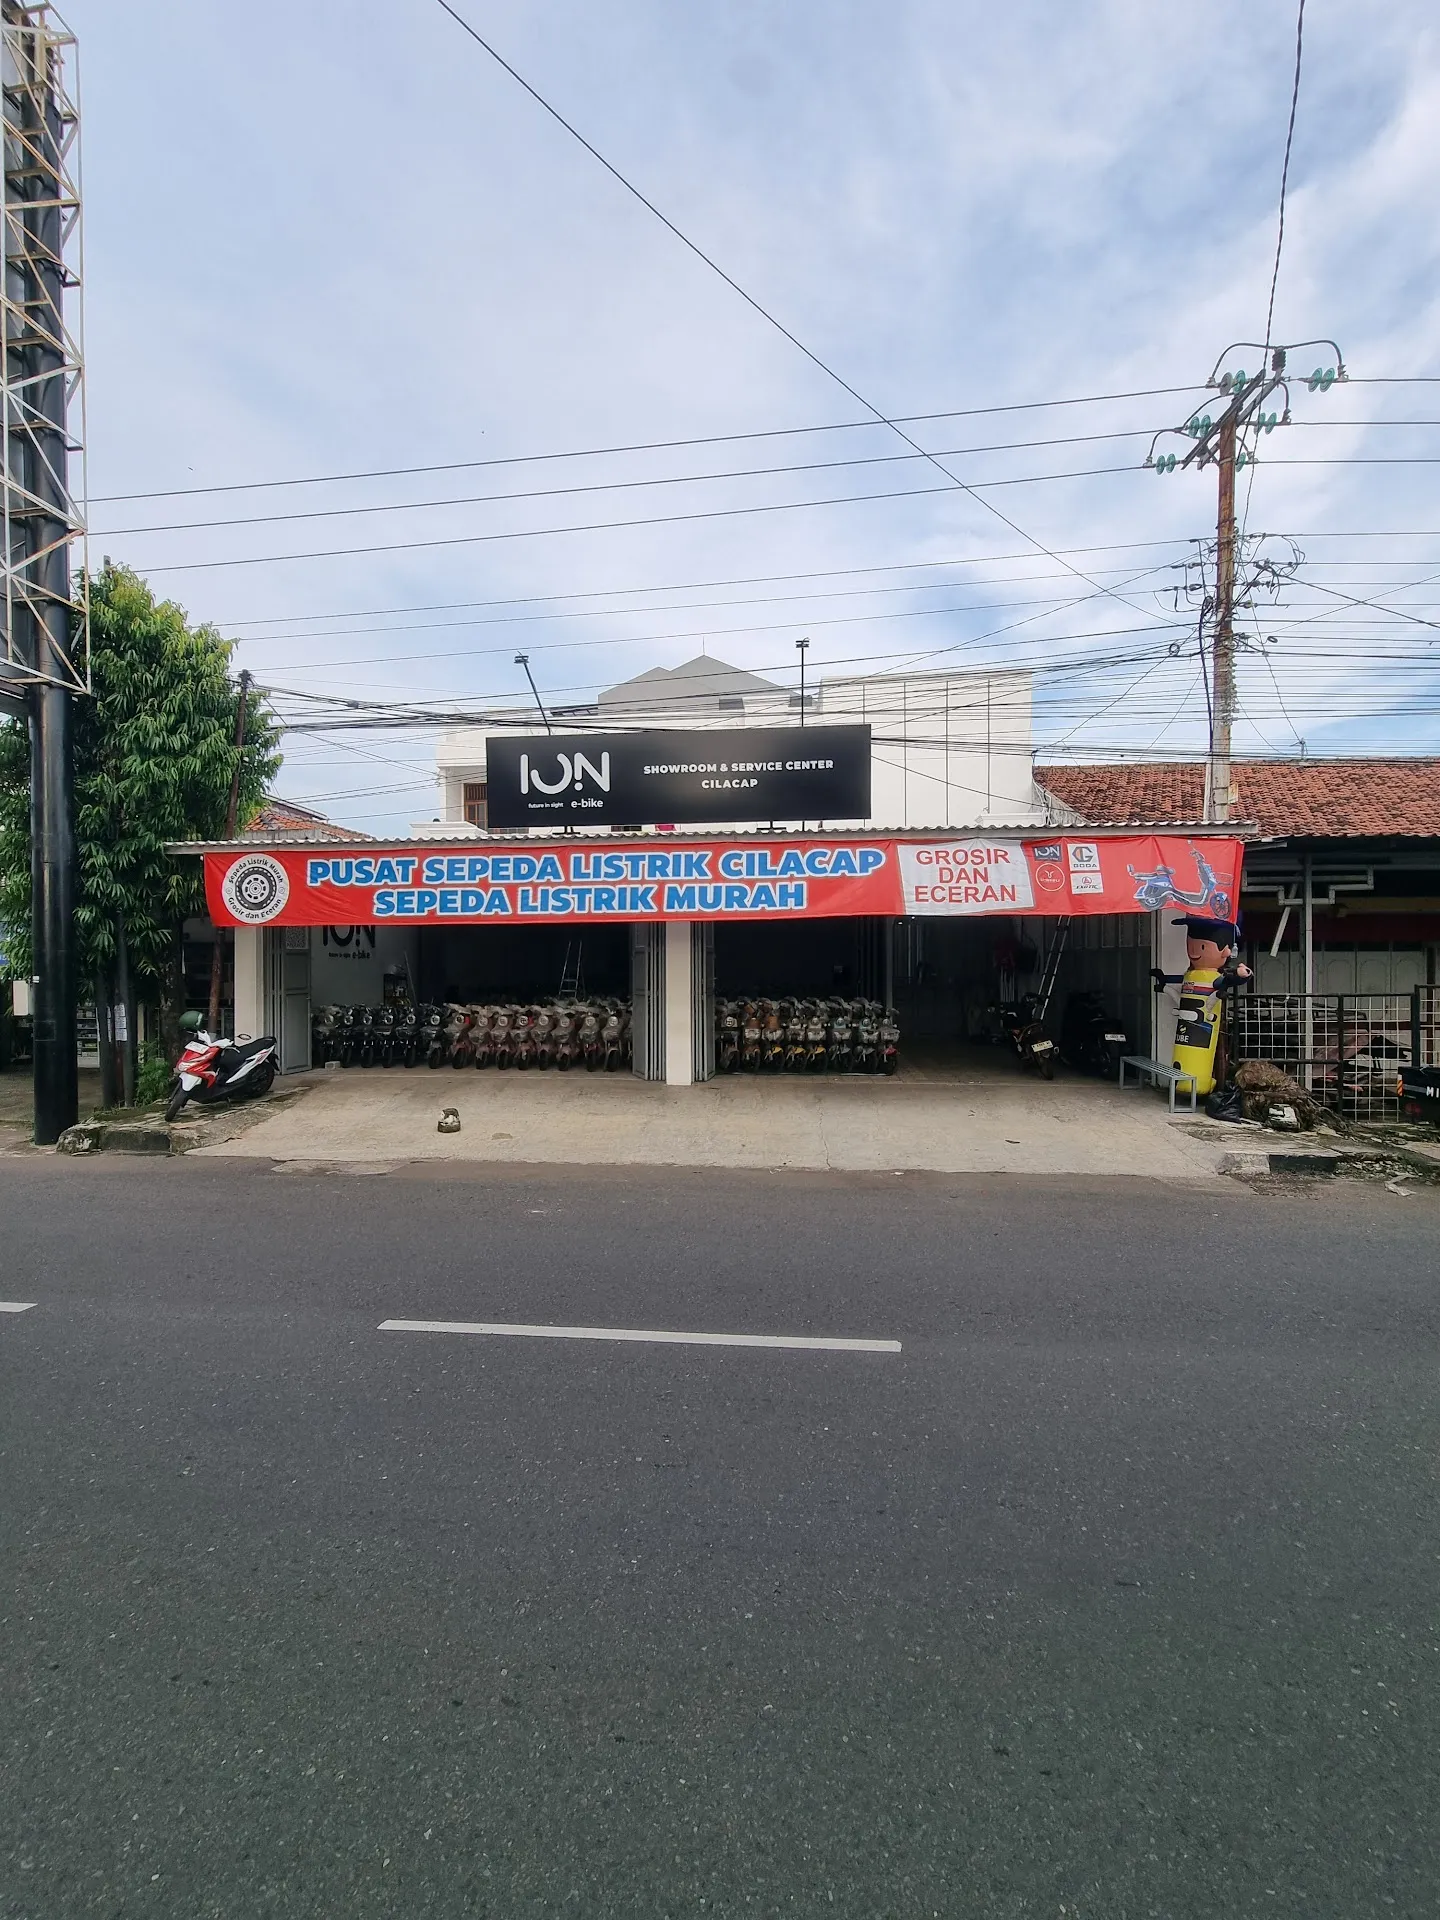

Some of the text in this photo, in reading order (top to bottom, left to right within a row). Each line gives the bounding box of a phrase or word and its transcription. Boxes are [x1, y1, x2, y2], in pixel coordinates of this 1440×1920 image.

[643, 759, 834, 775] SHOWROOM & SERVICE CENTER
[701, 778, 758, 789] CILACAP
[571, 798, 604, 808] e-bike
[915, 847, 1011, 866] GROSIR
[228, 858, 284, 884] Sepeda Listrik Murah
[308, 848, 886, 886] PUSAT SEPEDA LISTRIK CILACAP
[938, 866, 989, 884] DAN
[373, 881, 807, 917] SEPEDA LISTRIK MURAH
[914, 885, 1017, 904] ECERAN
[228, 897, 244, 916] Grosir
[261, 899, 282, 918] Eceran
